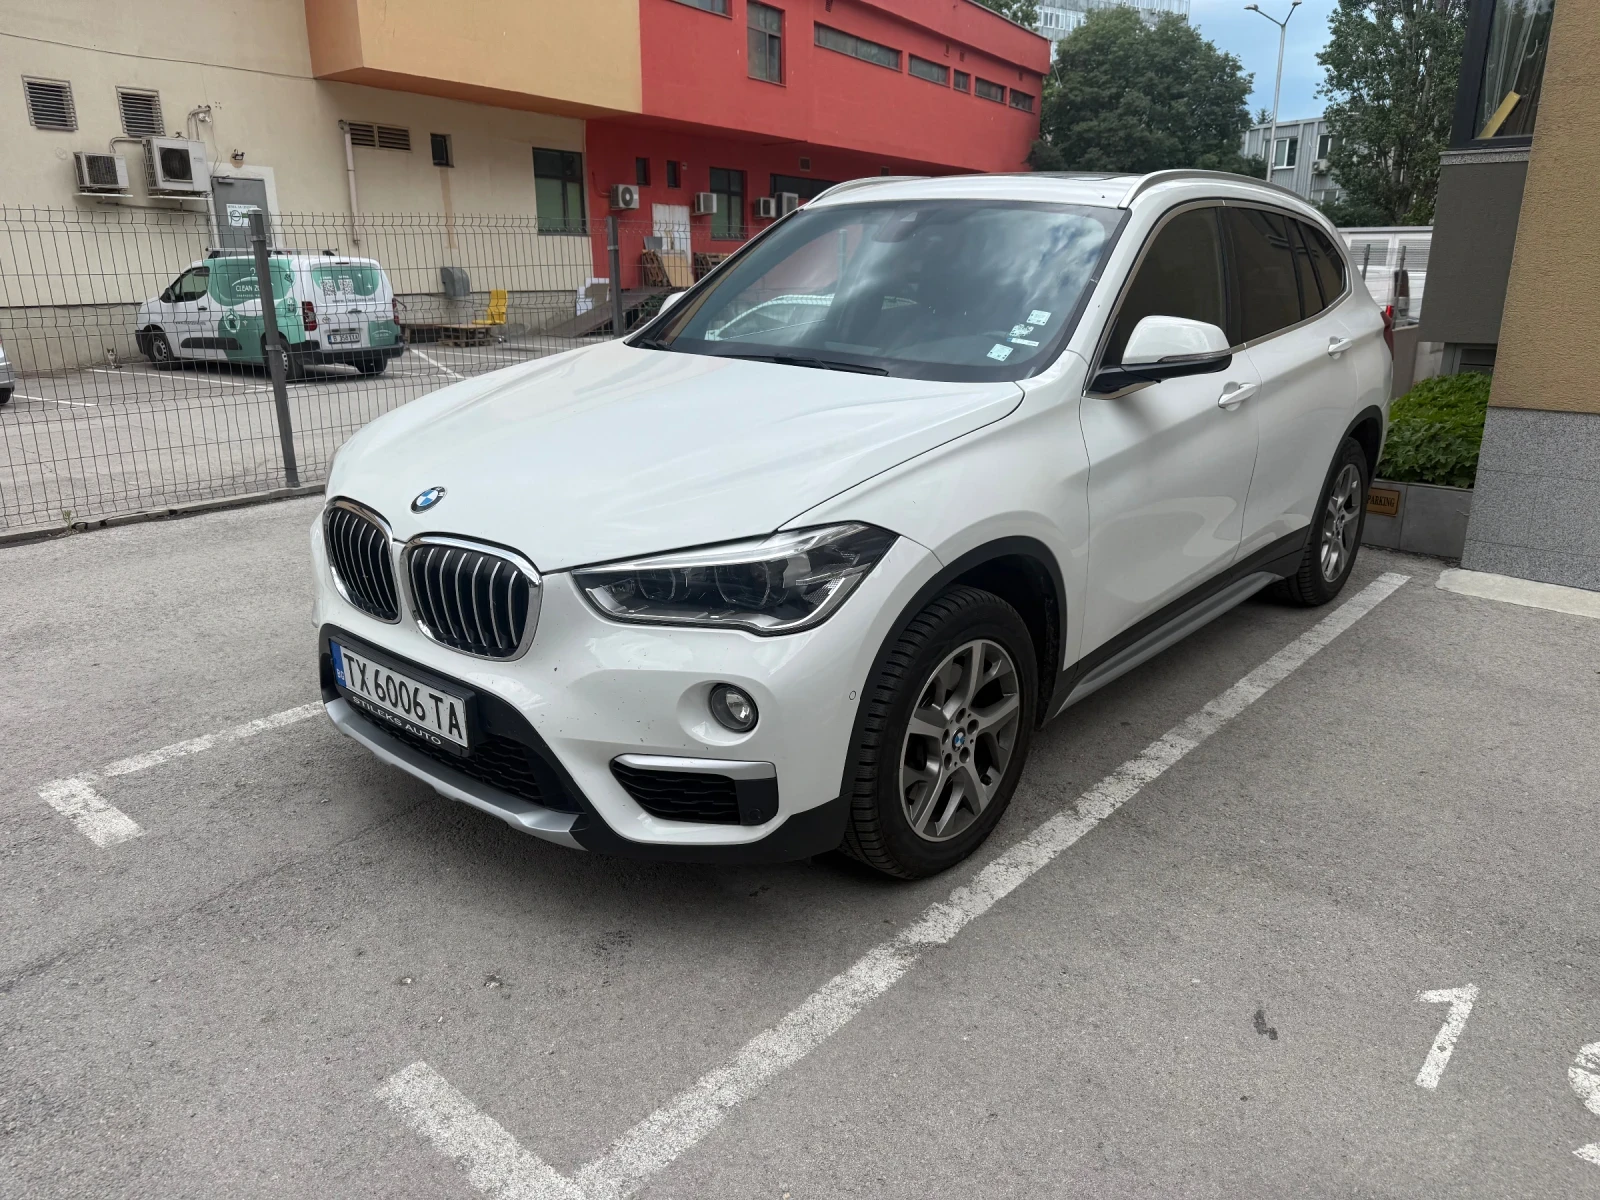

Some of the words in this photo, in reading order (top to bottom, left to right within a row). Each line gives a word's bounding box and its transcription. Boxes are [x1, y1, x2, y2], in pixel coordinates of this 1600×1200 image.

[1366, 494, 1395, 508] PARKING
[336, 668, 345, 681] BG
[352, 696, 402, 726] STILEKS
[405, 722, 442, 745] AUTO
